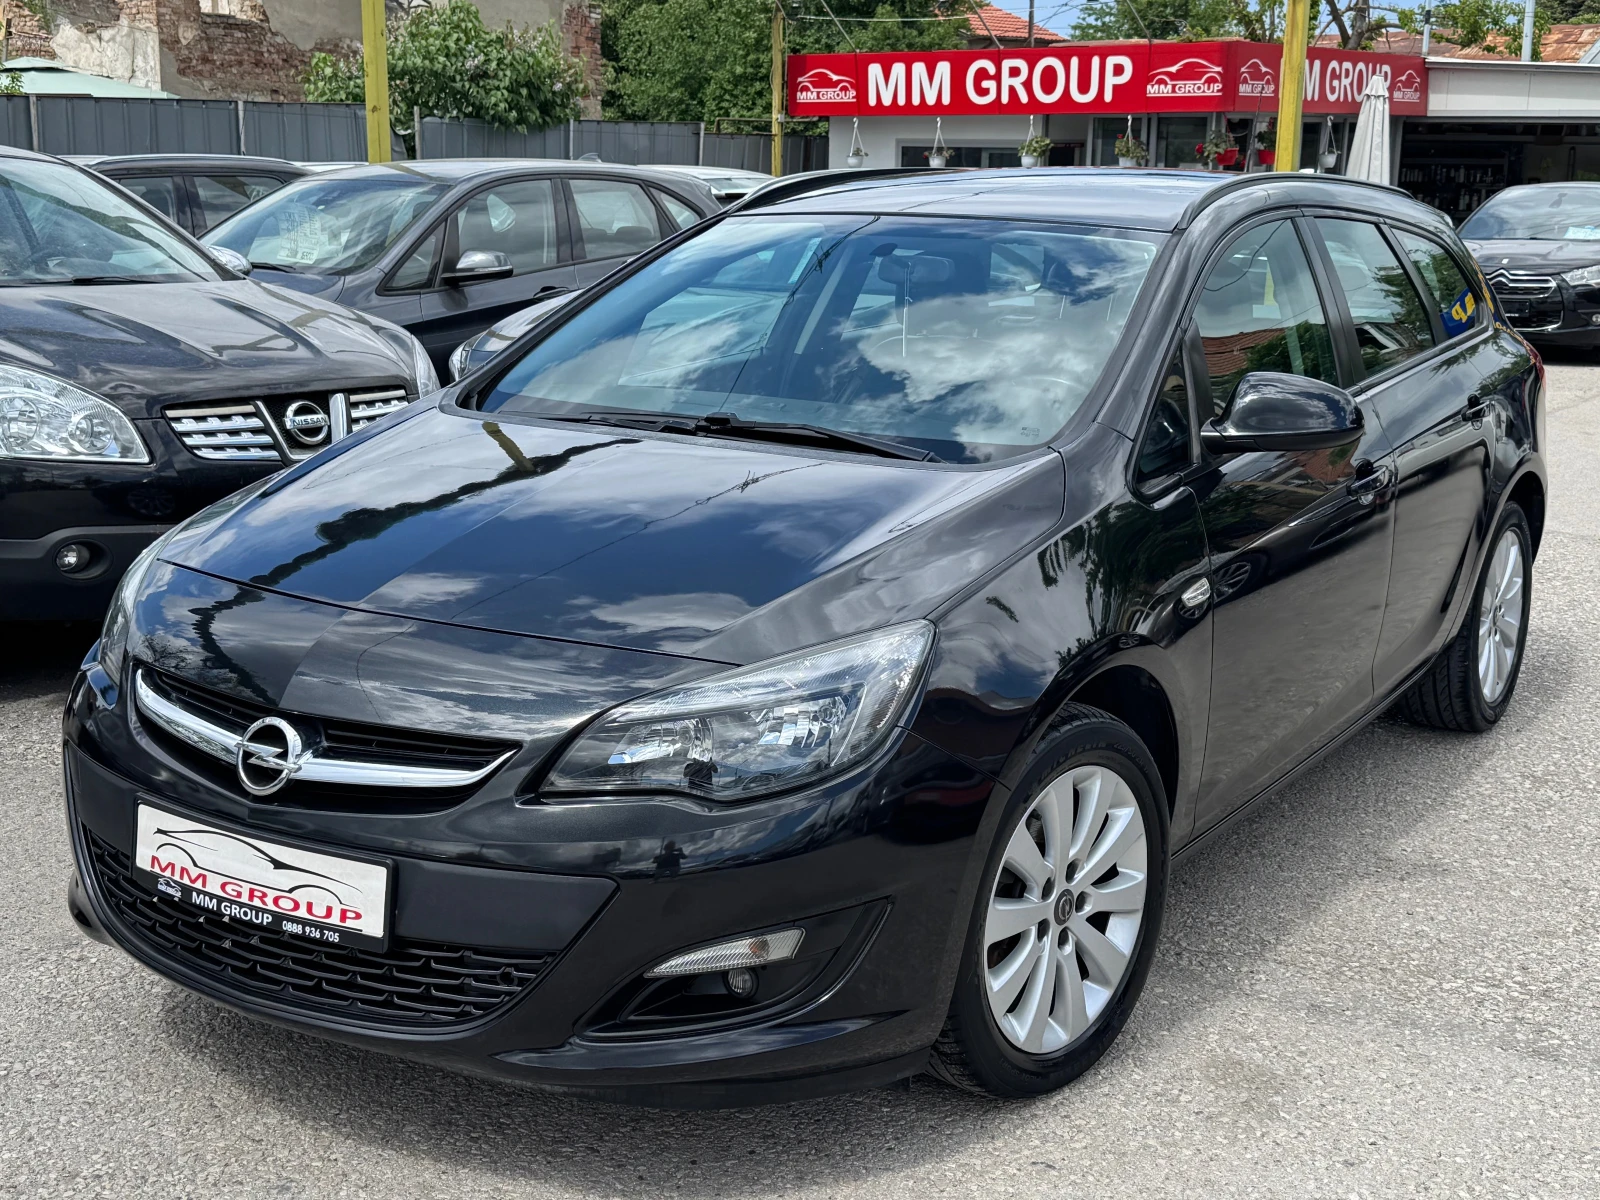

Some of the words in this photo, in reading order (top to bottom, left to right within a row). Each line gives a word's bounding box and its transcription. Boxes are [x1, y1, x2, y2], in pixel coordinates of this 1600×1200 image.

[867, 61, 951, 106] MM
[965, 55, 1134, 105] GROUP
[1146, 83, 1172, 94] MM
[1175, 82, 1223, 93] GROUP
[1239, 83, 1251, 93] MM
[796, 90, 817, 100] MM
[819, 90, 857, 100] GROUP
[291, 416, 327, 427] NISSAN
[150, 854, 207, 889] MM
[220, 881, 363, 924] GROUP
[191, 891, 217, 911] MM
[220, 902, 272, 926] GROUP
[282, 920, 303, 935] 0888
[305, 926, 320, 939] 936
[323, 930, 340, 943] 705
